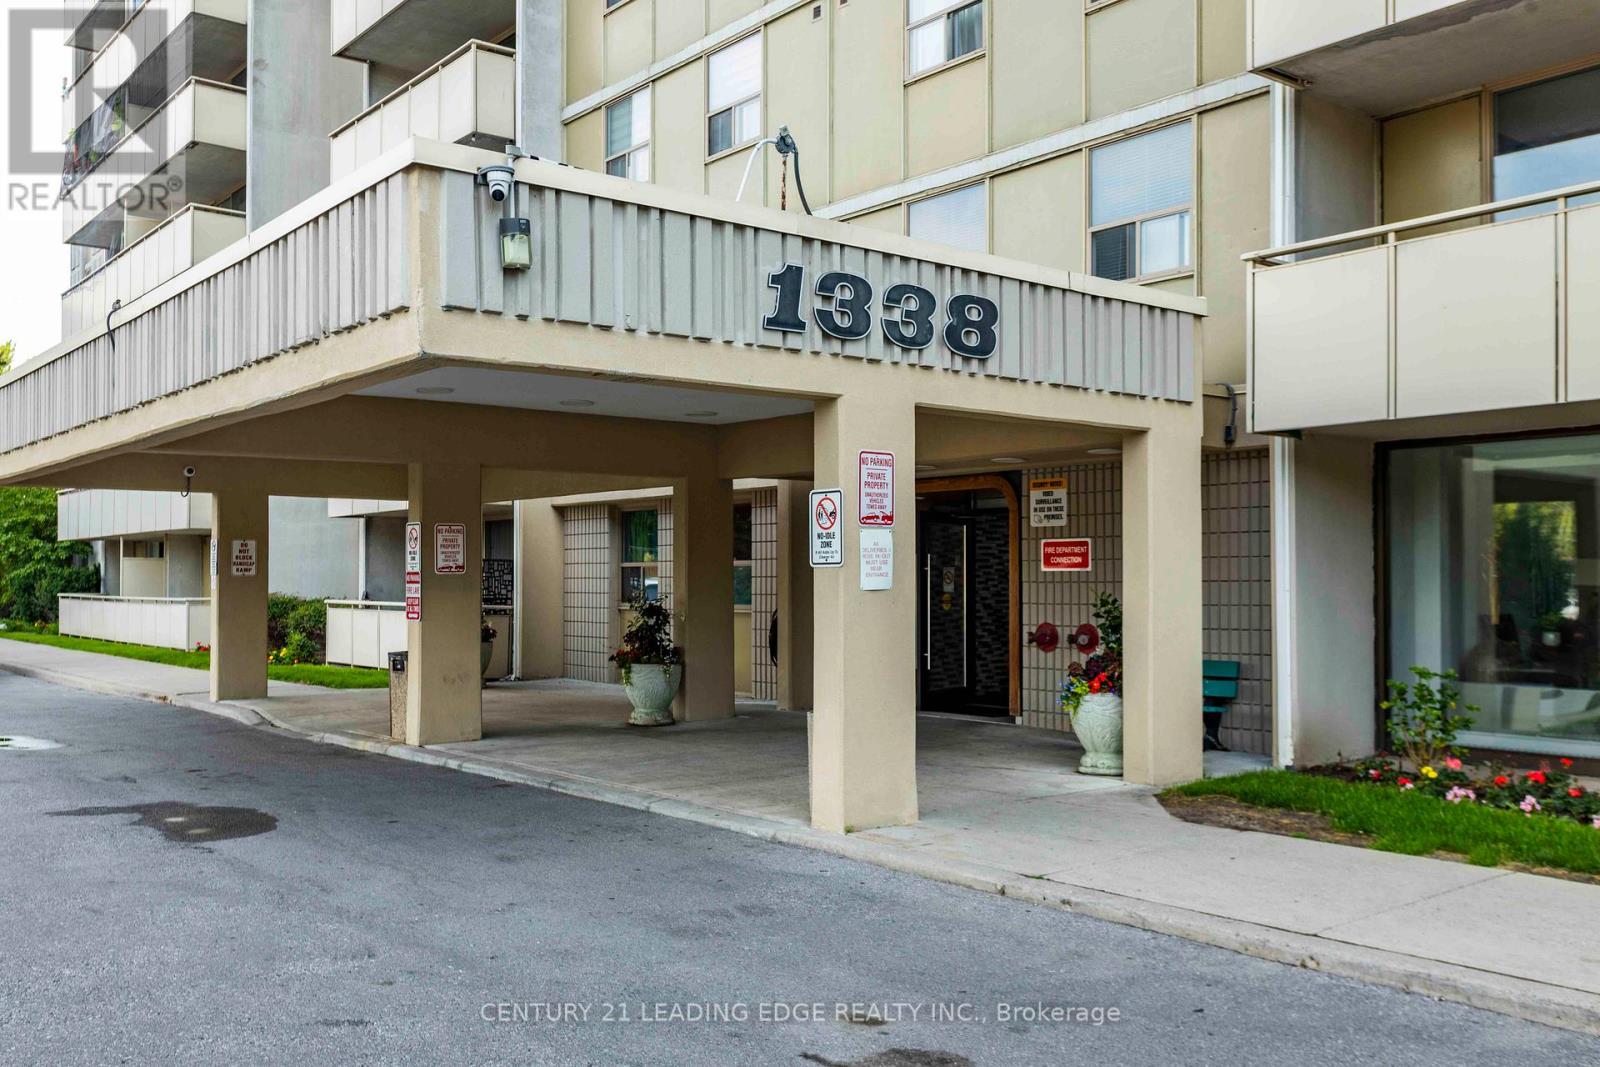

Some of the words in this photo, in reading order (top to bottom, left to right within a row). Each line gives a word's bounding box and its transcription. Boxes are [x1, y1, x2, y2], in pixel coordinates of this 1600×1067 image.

[763, 262, 1000, 360] 1338
[870, 457, 892, 467] PARKING
[867, 472, 886, 480] PRIVATE
[864, 481, 888, 489] PROPERTY
[1056, 546, 1087, 554] DEPARTMENT
[1051, 556, 1082, 564] CONNECTION
